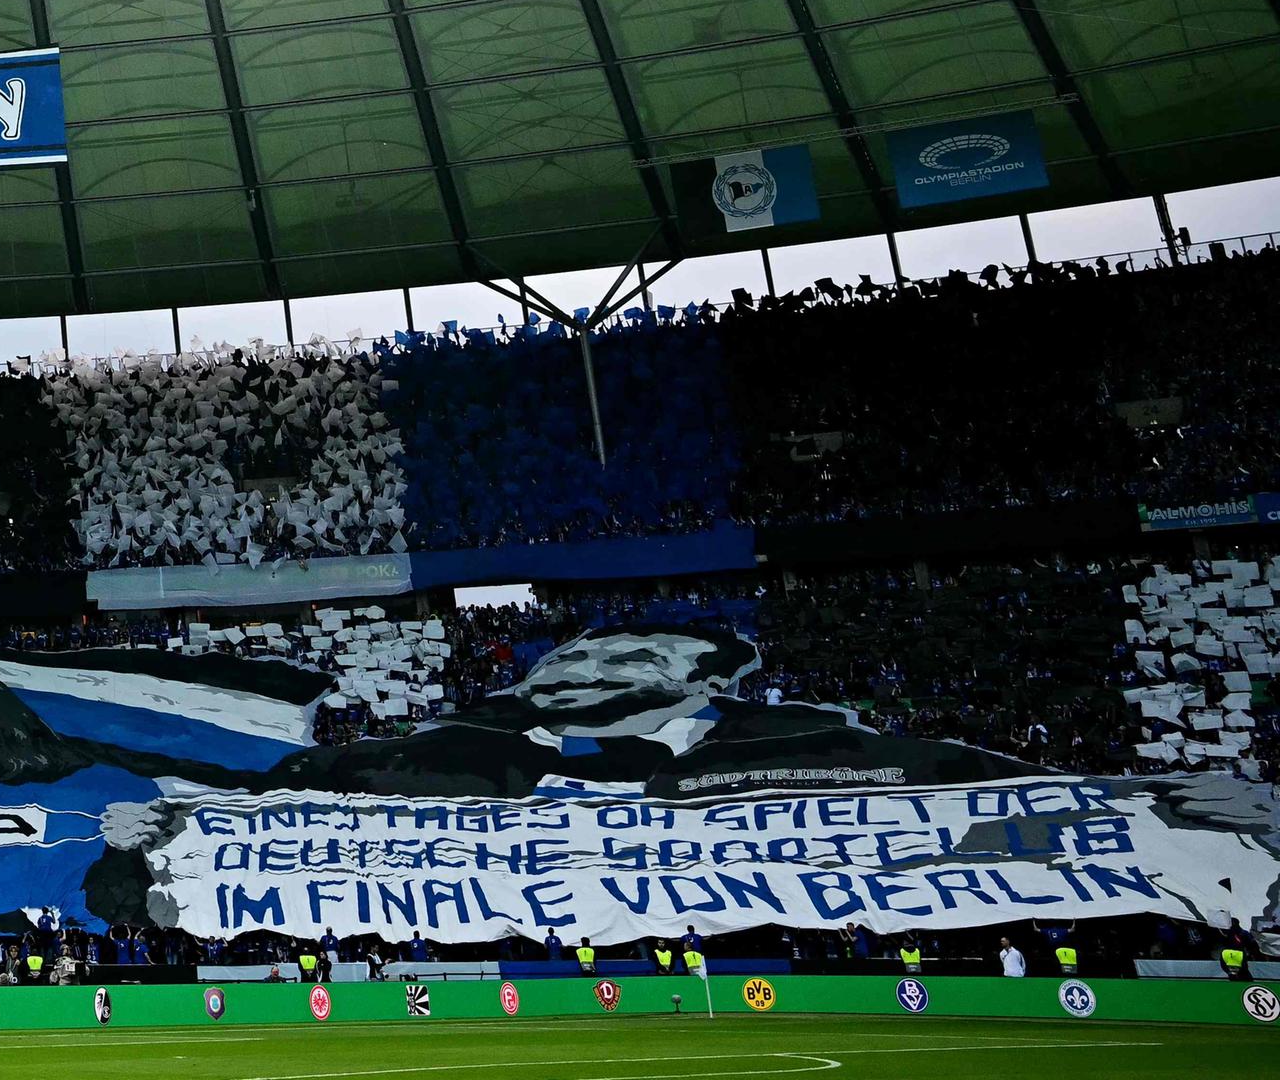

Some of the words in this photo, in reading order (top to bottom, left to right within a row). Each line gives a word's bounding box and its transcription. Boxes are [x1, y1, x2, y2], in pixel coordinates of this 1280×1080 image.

[914, 161, 1025, 186] OLYMPIASTADION
[949, 173, 992, 187] BERLIN
[678, 767, 906, 791] SÜDTRIBÜNE
[375, 803, 570, 832] TAGES
[703, 794, 935, 831] SPIELT
[967, 783, 1117, 816] DER
[216, 879, 285, 929] IM
[307, 877, 577, 928] FINALE
[600, 871, 787, 914] VON
[797, 863, 1162, 919] BERLIN
[747, 981, 772, 1001] BVB
